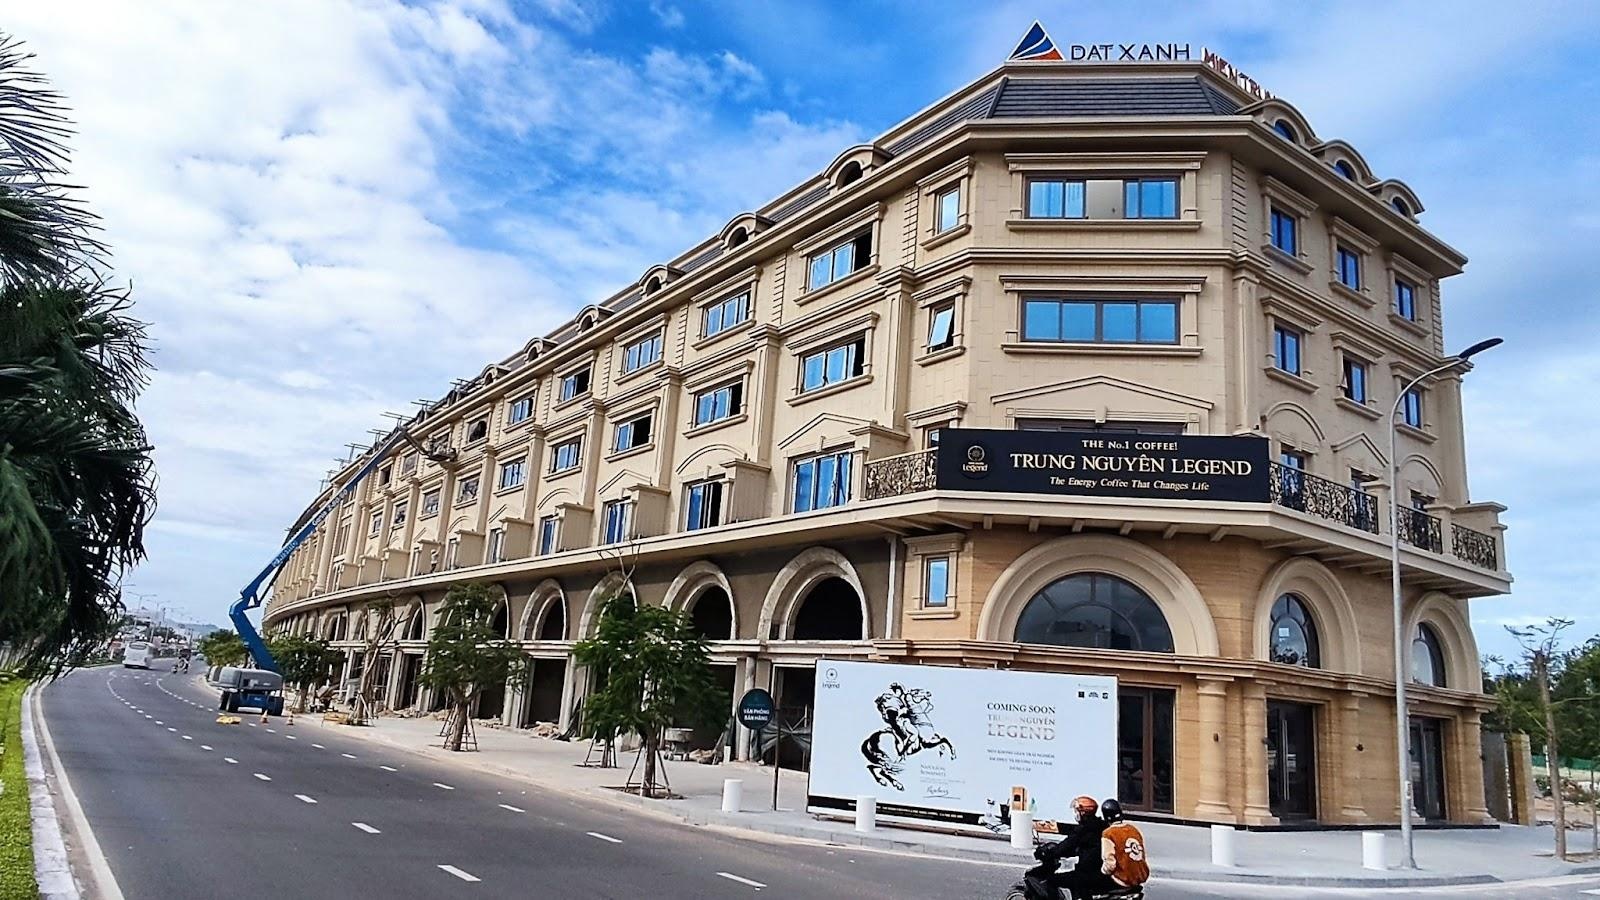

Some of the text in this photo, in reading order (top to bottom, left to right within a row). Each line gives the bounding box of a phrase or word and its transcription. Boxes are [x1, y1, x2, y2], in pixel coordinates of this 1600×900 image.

[1118, 43, 1190, 60] XANH
[1081, 439, 1178, 451] THE No.1 COFFEE!
[962, 463, 988, 473] Legend
[1009, 453, 1252, 476] TRUNG NGUYÊN LEGEND
[1050, 476, 1210, 492] The Energy Coffee That Changes Life
[987, 702, 1056, 714] COMING SOON
[987, 723, 1056, 741] LEGEND
